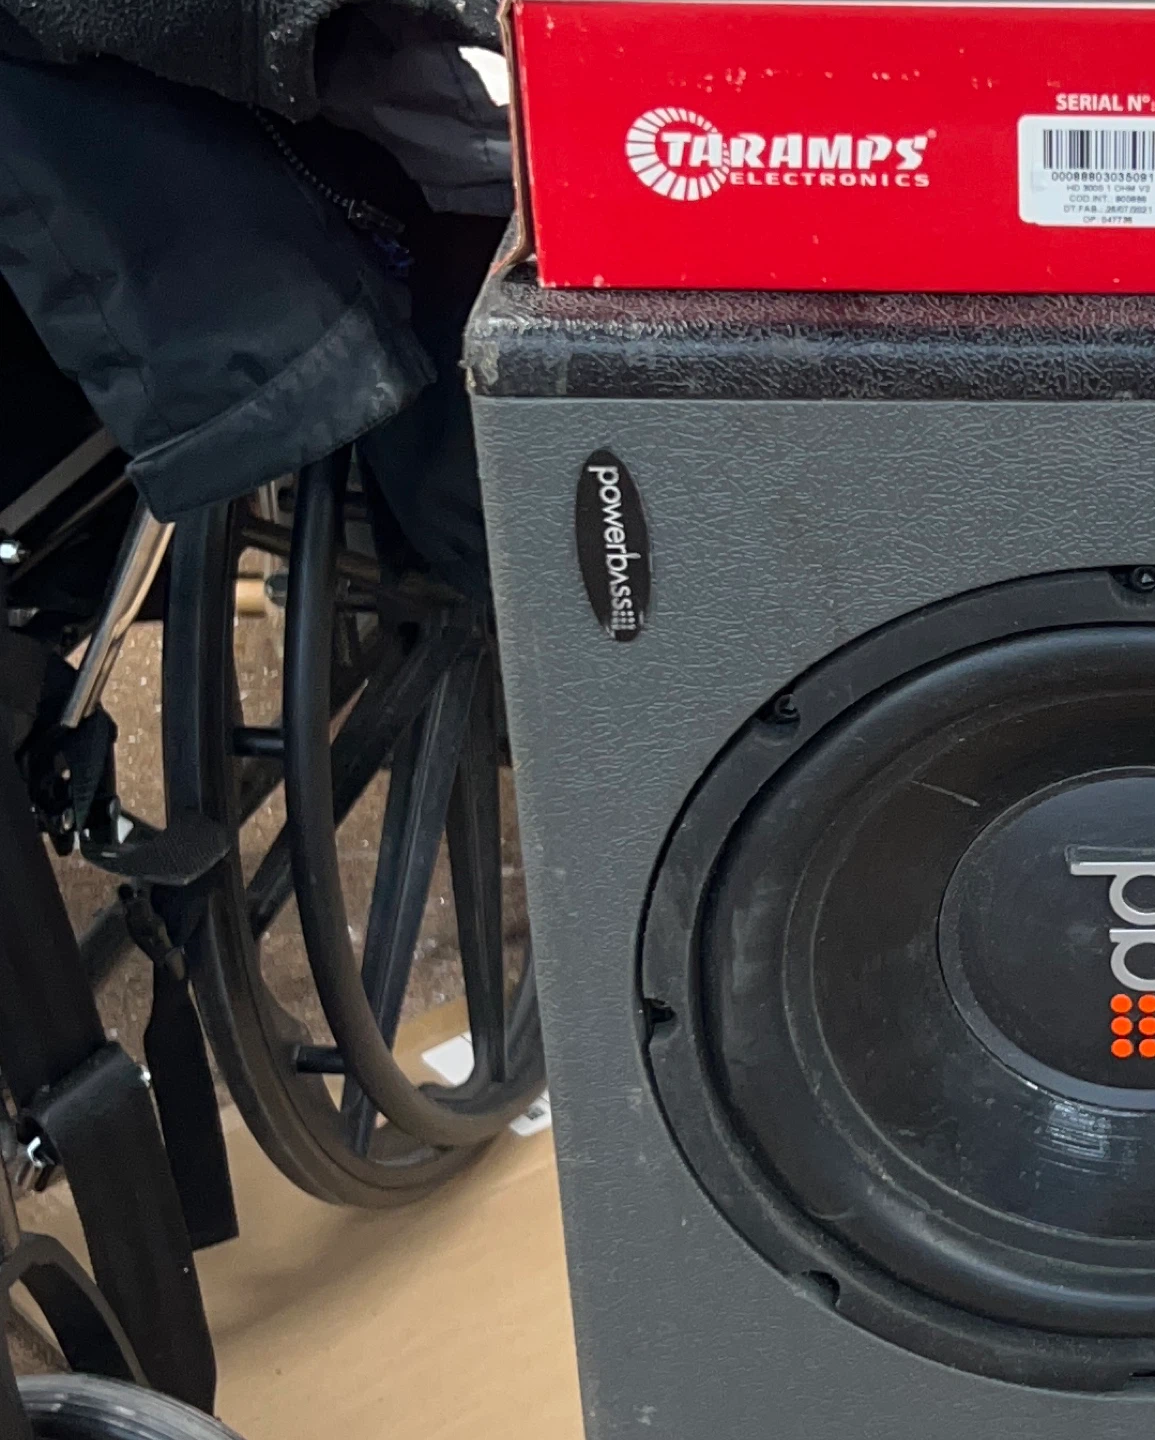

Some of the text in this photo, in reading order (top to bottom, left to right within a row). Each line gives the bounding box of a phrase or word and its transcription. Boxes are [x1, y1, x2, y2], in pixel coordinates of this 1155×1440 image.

[1055, 93, 1124, 112] SERIAL
[661, 132, 929, 171] TARAMPS
[731, 172, 930, 188] ELECTRONICS
[587, 465, 642, 611] powerbass
